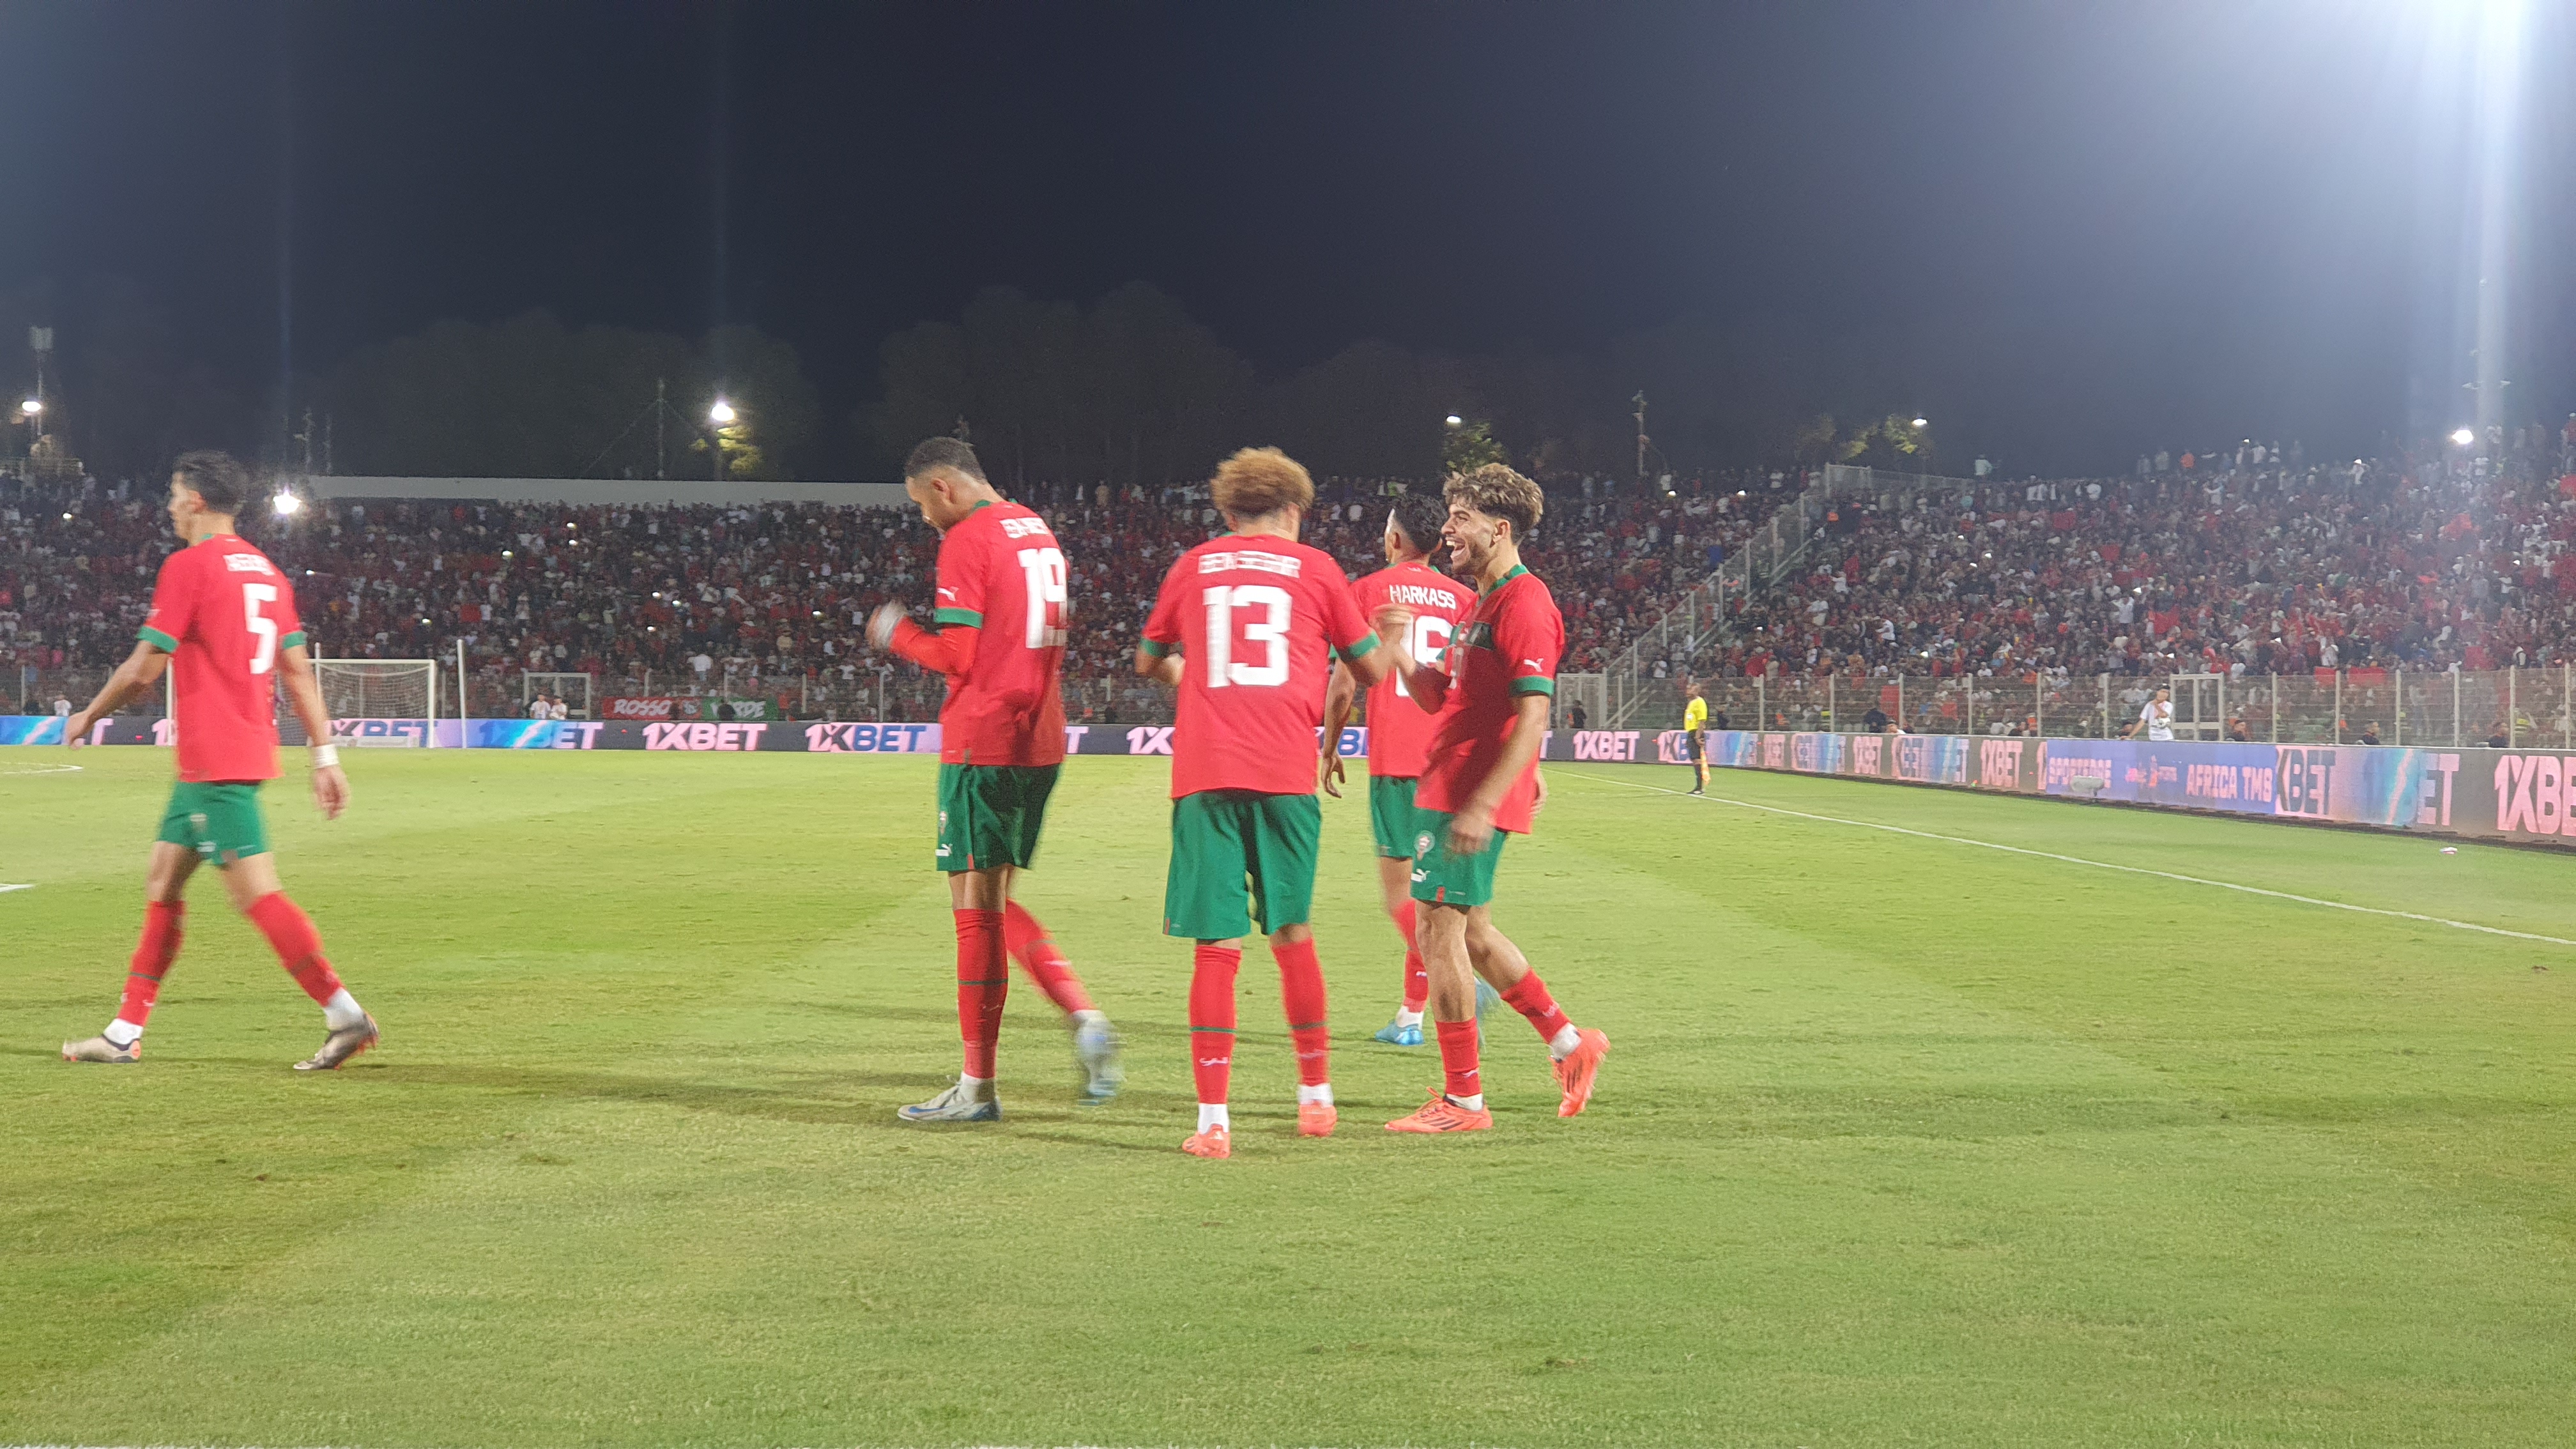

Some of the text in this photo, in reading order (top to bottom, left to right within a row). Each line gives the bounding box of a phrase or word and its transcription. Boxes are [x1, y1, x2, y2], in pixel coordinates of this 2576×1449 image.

[1016, 548, 1068, 648] 19
[1389, 584, 1456, 610] HARKASS
[242, 583, 278, 675] 5
[1202, 585, 1292, 688] 13
[613, 698, 671, 716] ROSSO
[642, 723, 767, 751] 1XBET
[805, 723, 926, 752] 1XBET
[1573, 730, 1640, 760] 1XBET
[2186, 764, 2238, 800] AFRICA
